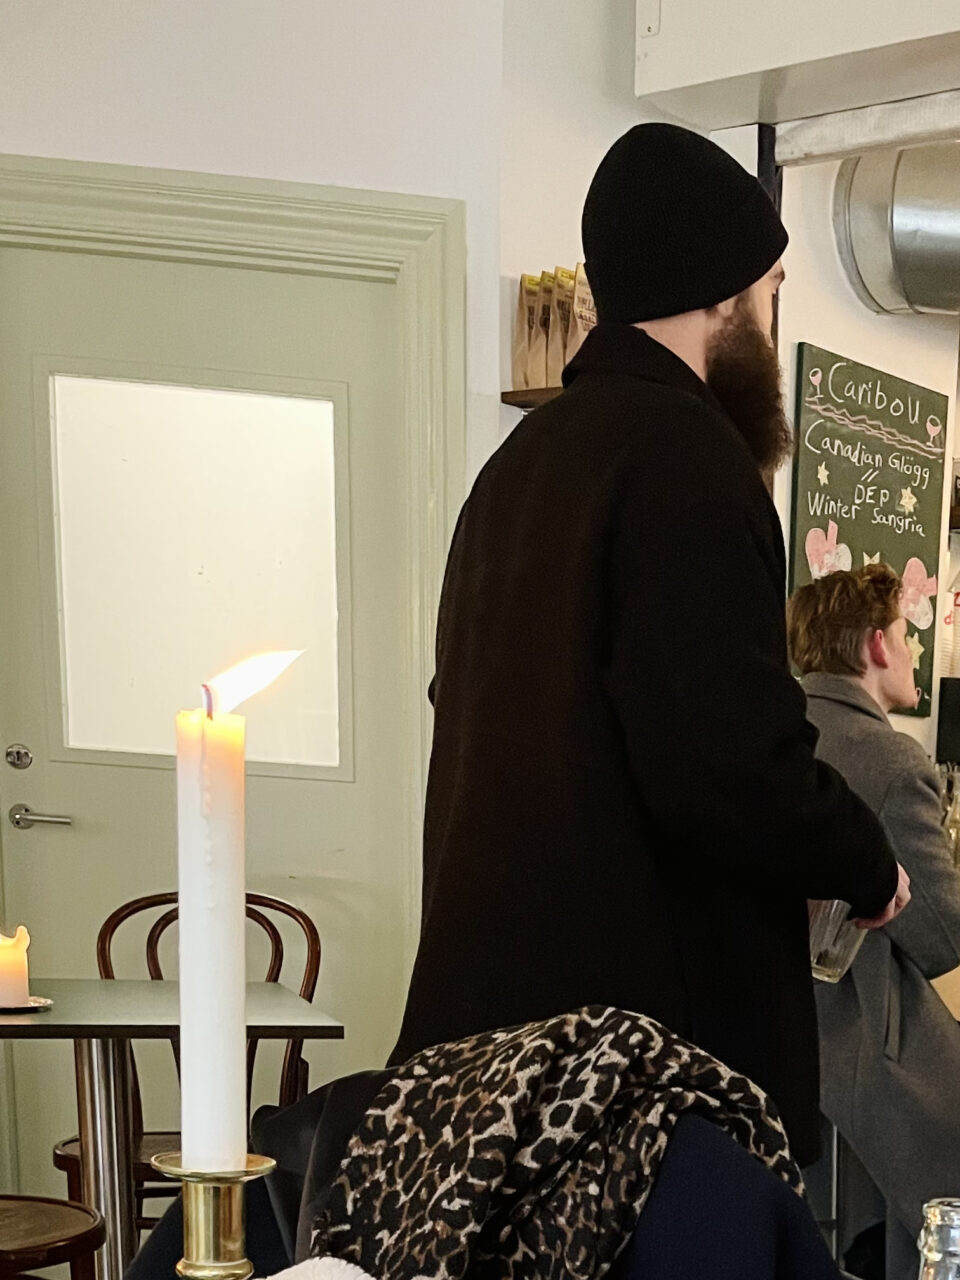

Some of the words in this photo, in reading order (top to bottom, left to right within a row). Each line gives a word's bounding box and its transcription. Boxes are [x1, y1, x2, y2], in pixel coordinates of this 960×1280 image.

[805, 420, 882, 467] Canadian
[888, 452, 930, 489] Glögg
[808, 491, 861, 520] Winter
[871, 507, 926, 537] Sangria
